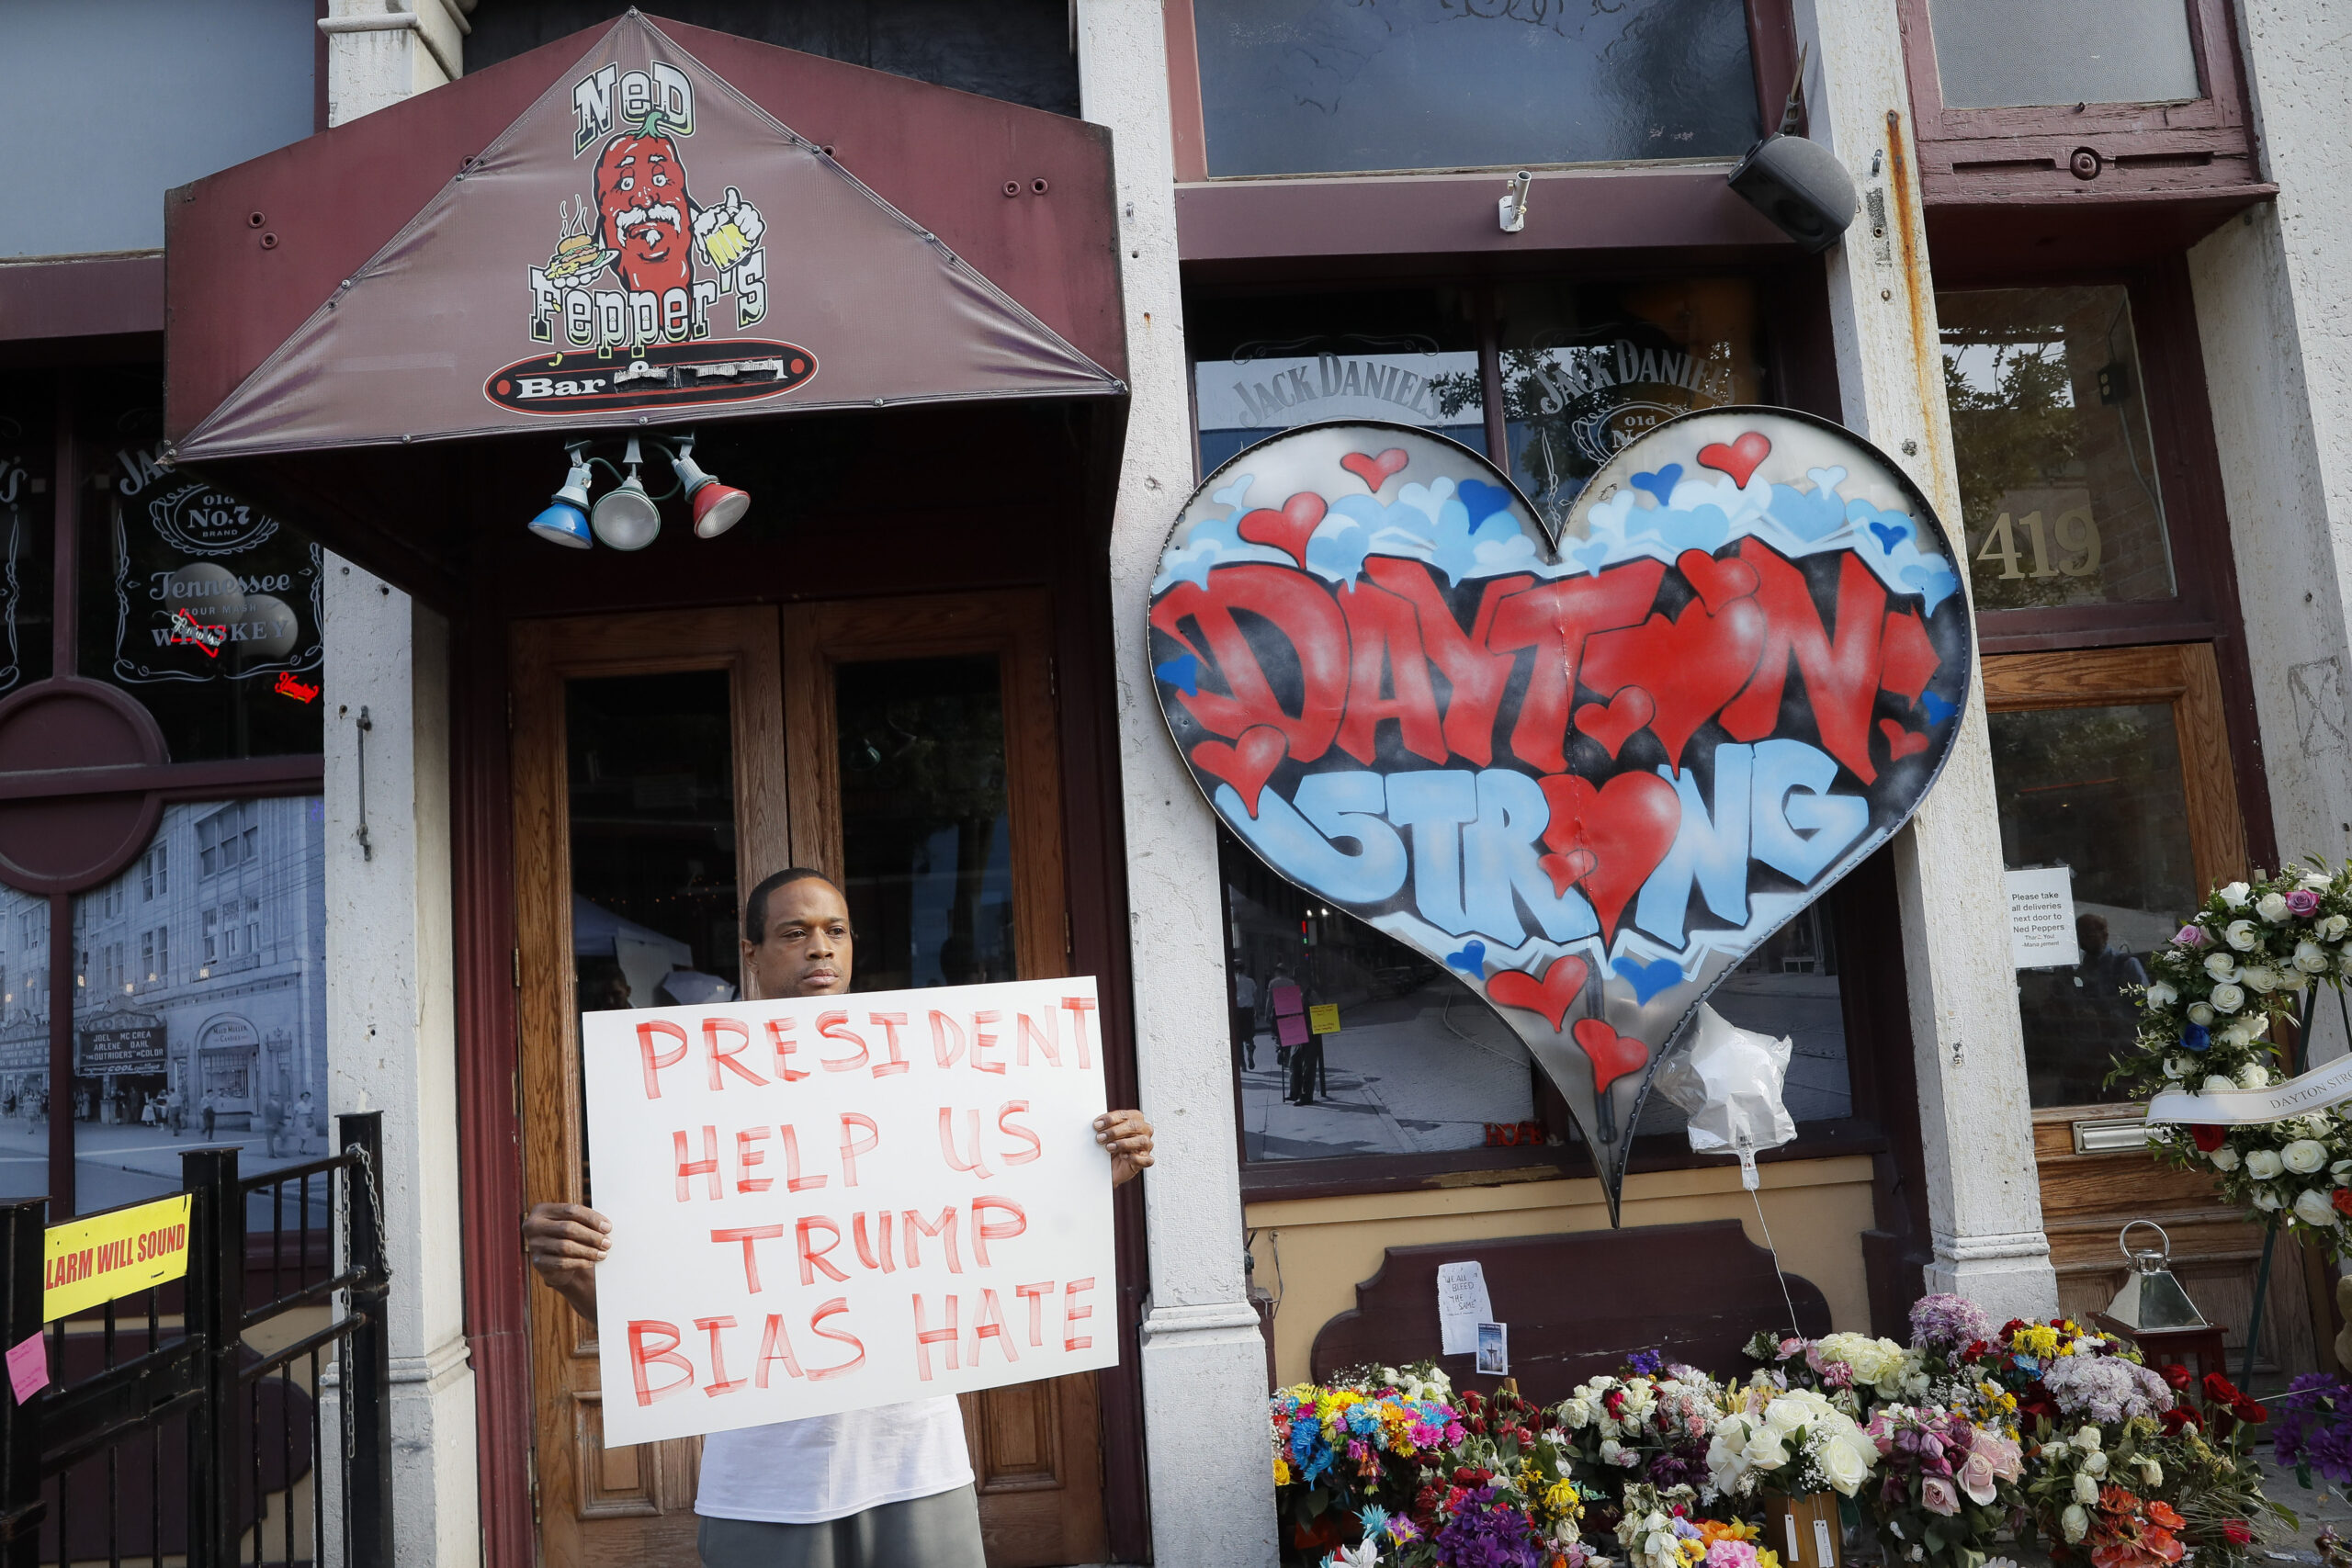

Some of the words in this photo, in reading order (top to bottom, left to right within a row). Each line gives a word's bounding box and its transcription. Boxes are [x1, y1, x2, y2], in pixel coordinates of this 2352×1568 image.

[515, 378, 606, 400] Bar
[1532, 354, 1615, 413] JACK
[1232, 366, 1317, 428] JACK
[1624, 415, 1657, 427] Old
[117, 441, 176, 496] JA
[202, 529, 239, 537] BRAND
[1976, 508, 2103, 580] 419
[149, 572, 290, 600] Tennessee
[222, 604, 257, 614] MASH
[1215, 738, 1869, 952] STRONG
[2011, 893, 2039, 901] Please
[2041, 891, 2059, 899] take
[2011, 904, 2021, 912] all
[2023, 902, 2062, 911] deliveries
[2013, 925, 2030, 933] Ned
[2031, 923, 2065, 933] Peppers
[636, 997, 1096, 1100] PRESIDENT
[2269, 1084, 2327, 1109] DAYTON
[673, 1112, 878, 1202] HELP
[938, 1100, 1041, 1179] US
[710, 1194, 1027, 1294] TRUMP
[45, 1247, 93, 1292] LARM
[96, 1239, 134, 1275] WILL
[137, 1223, 186, 1262] SOUND
[1452, 1281, 1475, 1292] BLEED
[1456, 1274, 1467, 1282] ALL
[1448, 1293, 1464, 1303] THE
[627, 1296, 865, 1407] BIAS
[912, 1276, 1095, 1382] HATE
